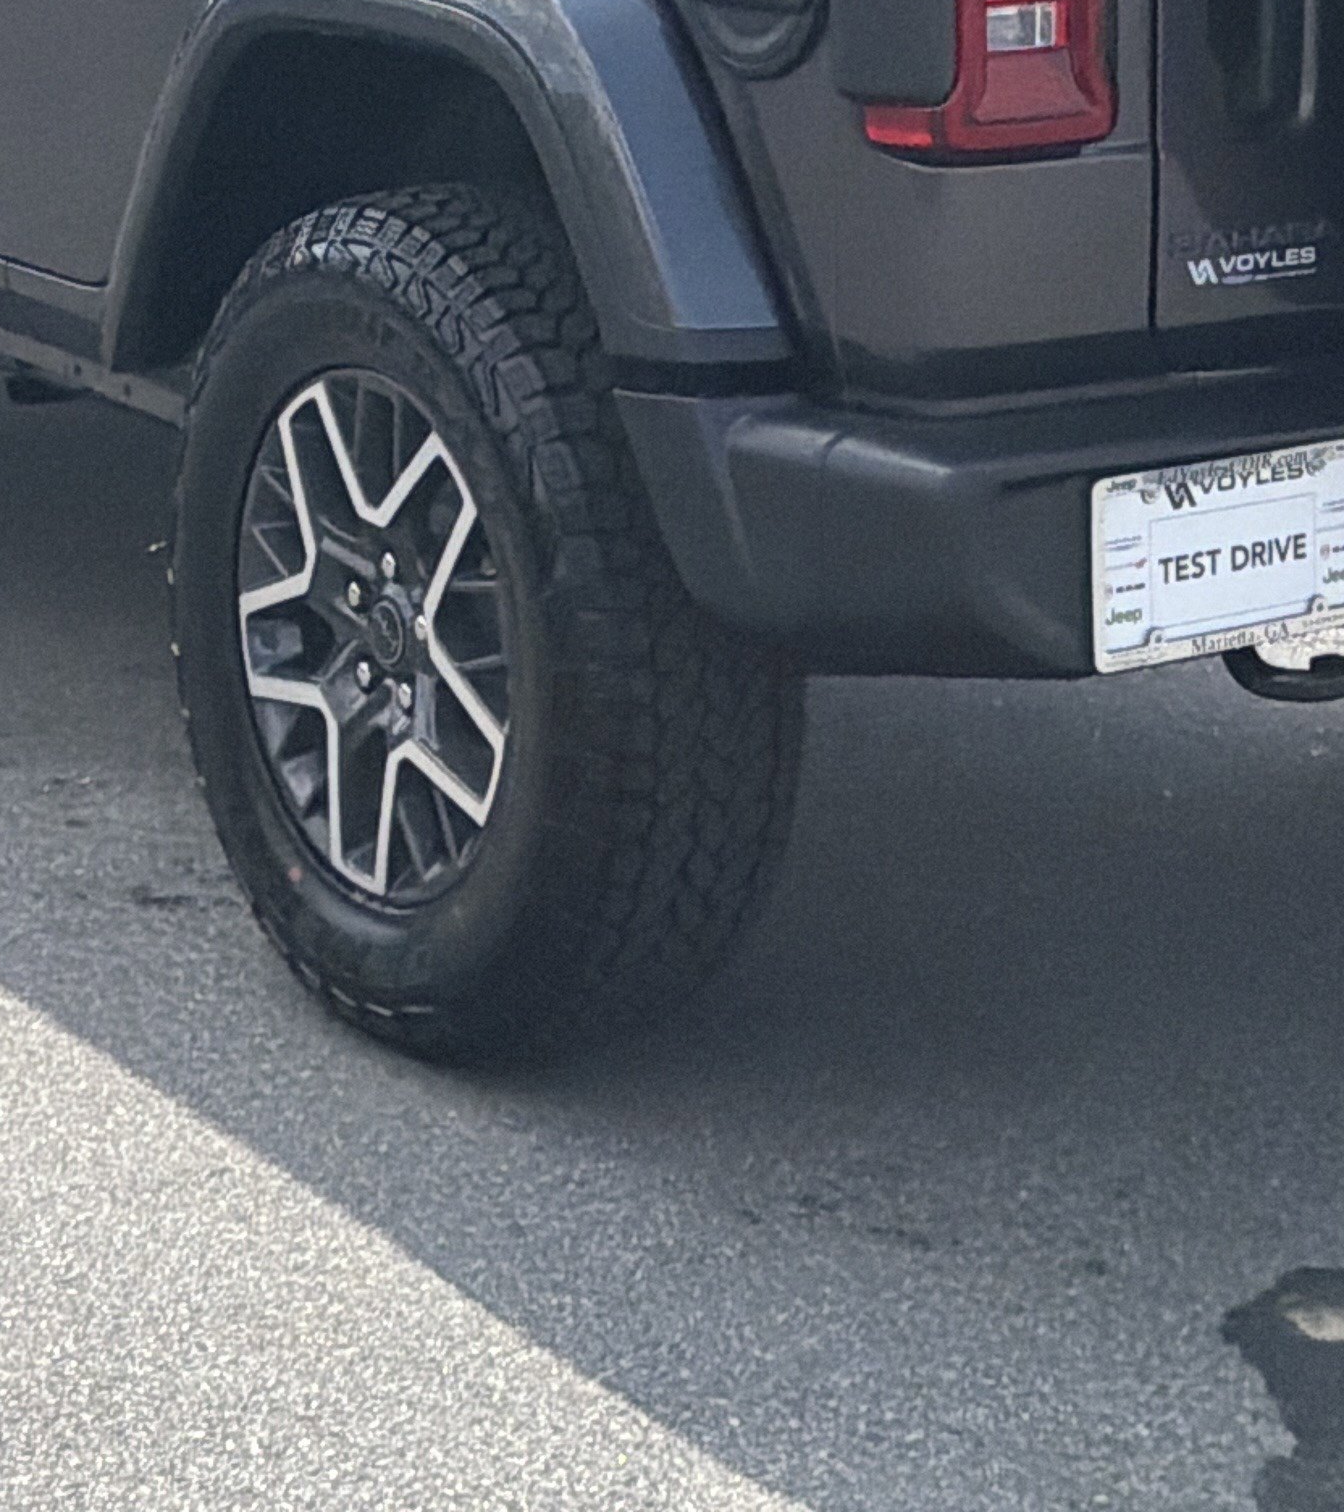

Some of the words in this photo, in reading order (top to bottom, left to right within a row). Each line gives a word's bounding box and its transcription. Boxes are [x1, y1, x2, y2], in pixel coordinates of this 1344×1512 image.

[1219, 246, 1316, 274] VOYLES
[1200, 465, 1304, 495] VOYLES
[1158, 549, 1221, 584] TEST
[1231, 533, 1306, 571] DRIVE
[1105, 607, 1142, 625] Jeep
